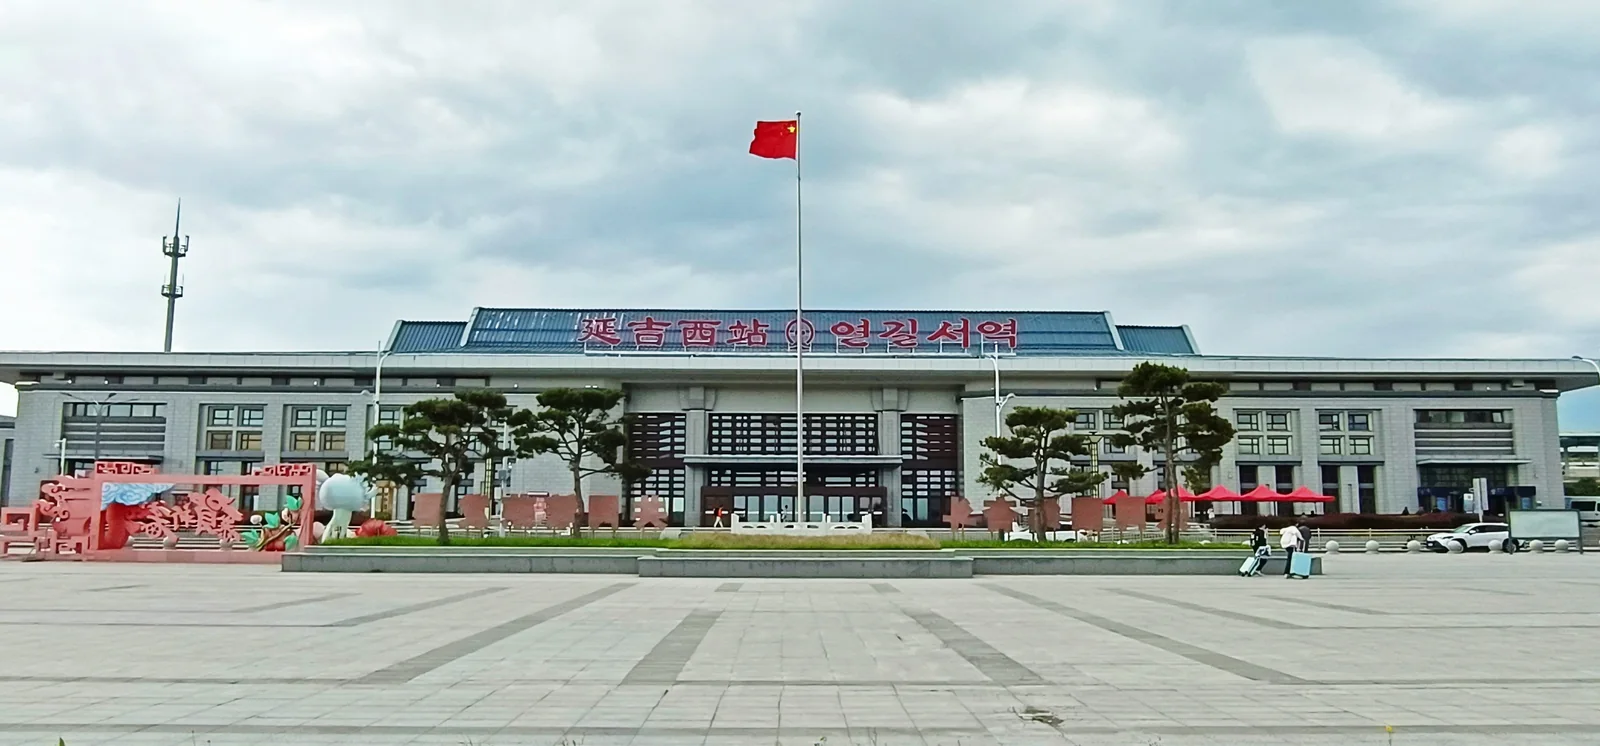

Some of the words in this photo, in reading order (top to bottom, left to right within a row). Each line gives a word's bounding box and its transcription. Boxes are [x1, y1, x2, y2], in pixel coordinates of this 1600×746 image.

[578, 316, 769, 346] 延吉西站
[830, 318, 1017, 348] 연길서역
